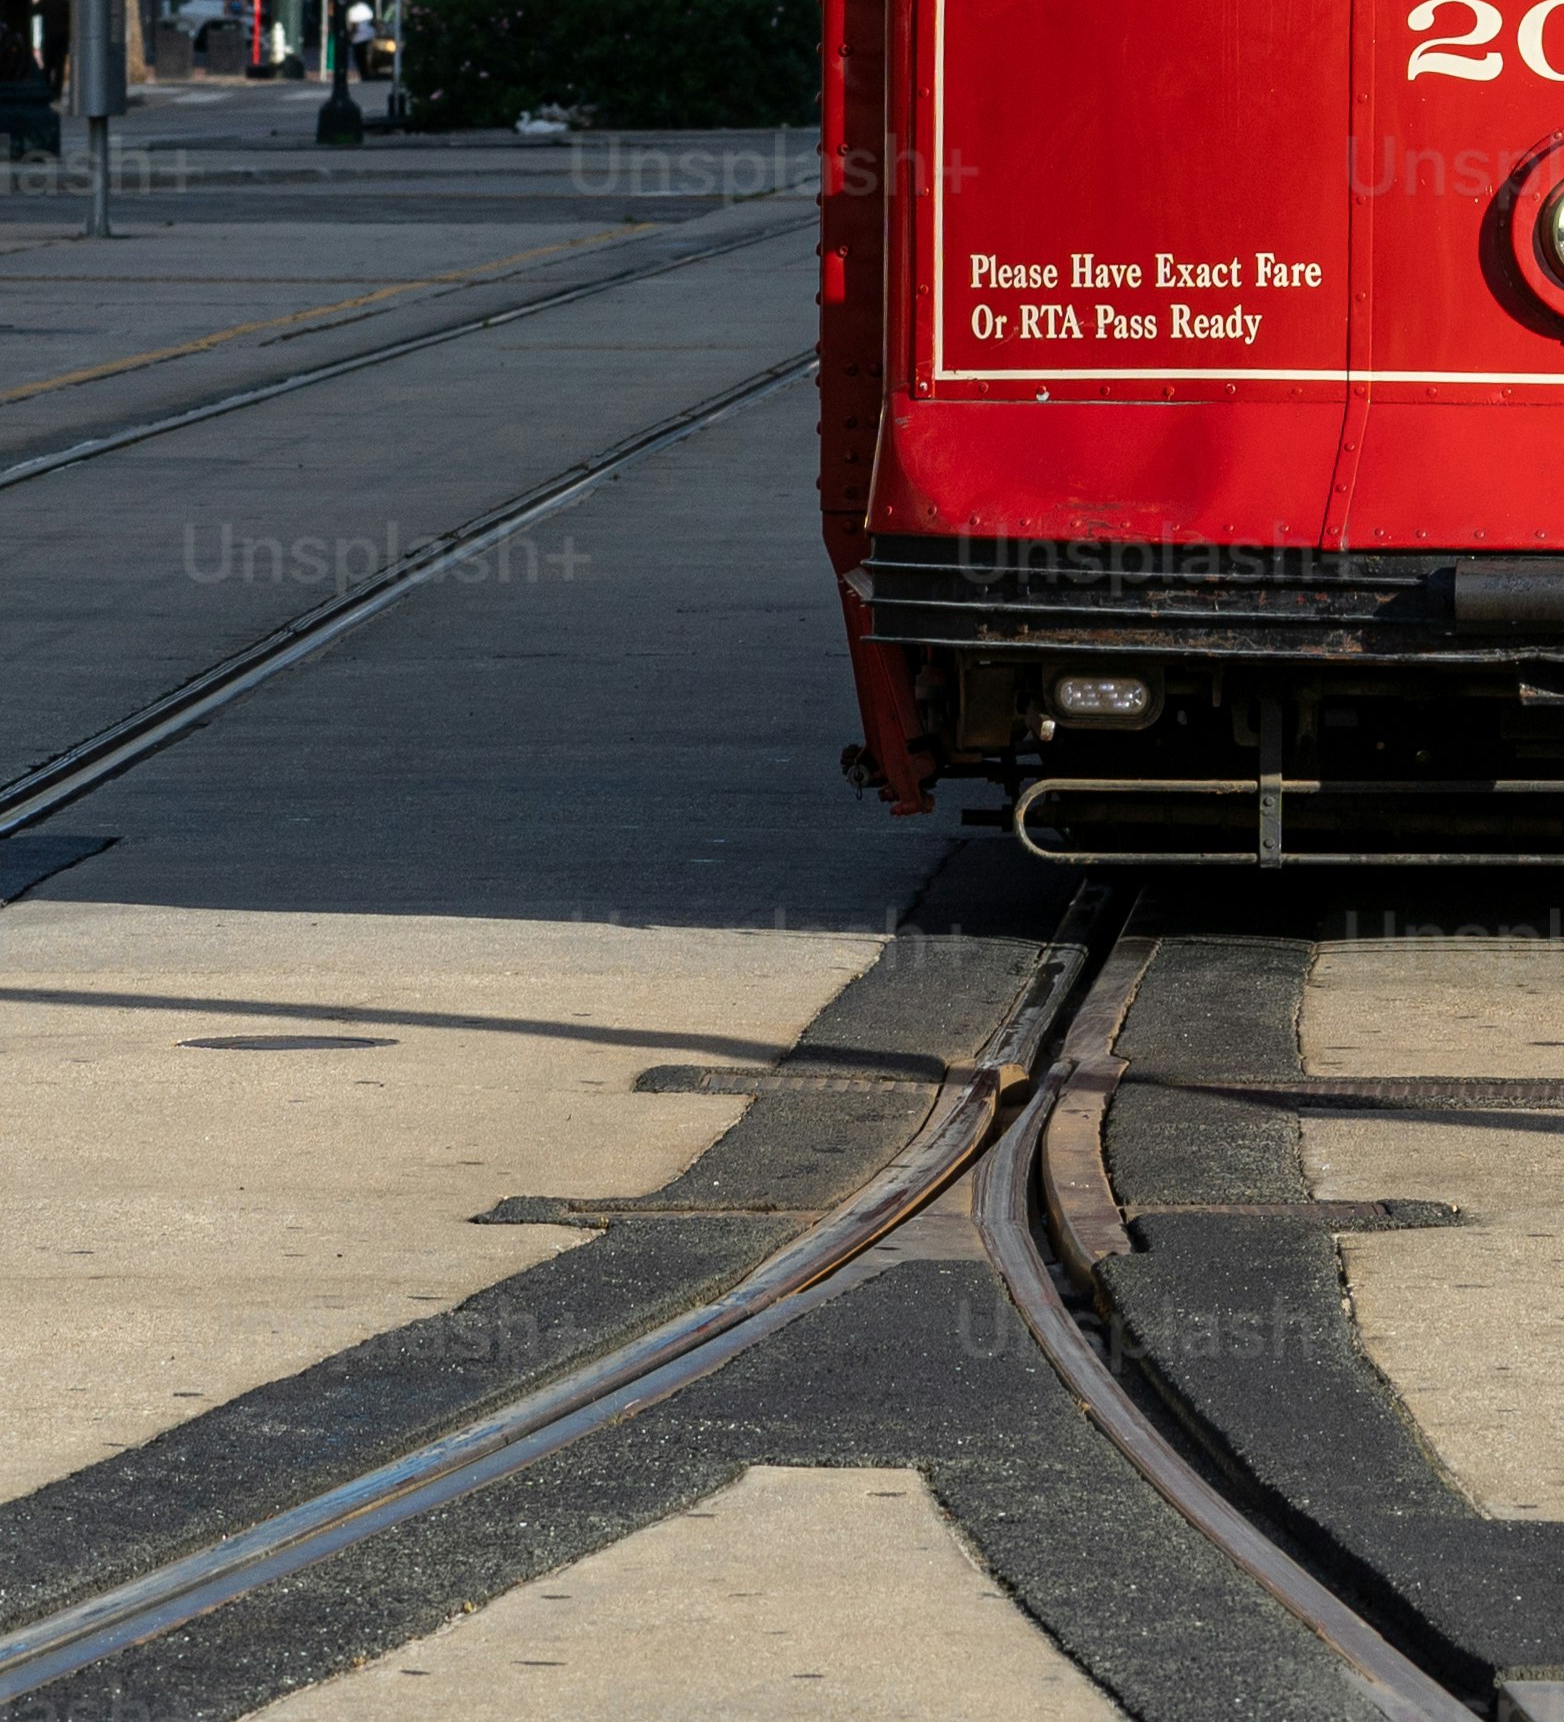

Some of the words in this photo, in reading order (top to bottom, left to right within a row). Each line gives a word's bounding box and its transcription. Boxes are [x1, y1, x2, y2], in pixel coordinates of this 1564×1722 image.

[970, 254, 1058, 289] Please
[1071, 253, 1142, 288] Have
[1155, 253, 1242, 288] Exact
[1255, 253, 1323, 288] Fare
[971, 304, 1008, 340] Or
[1020, 304, 1084, 339] RTA
[1095, 304, 1158, 339] Pass
[1170, 304, 1263, 345] Ready
